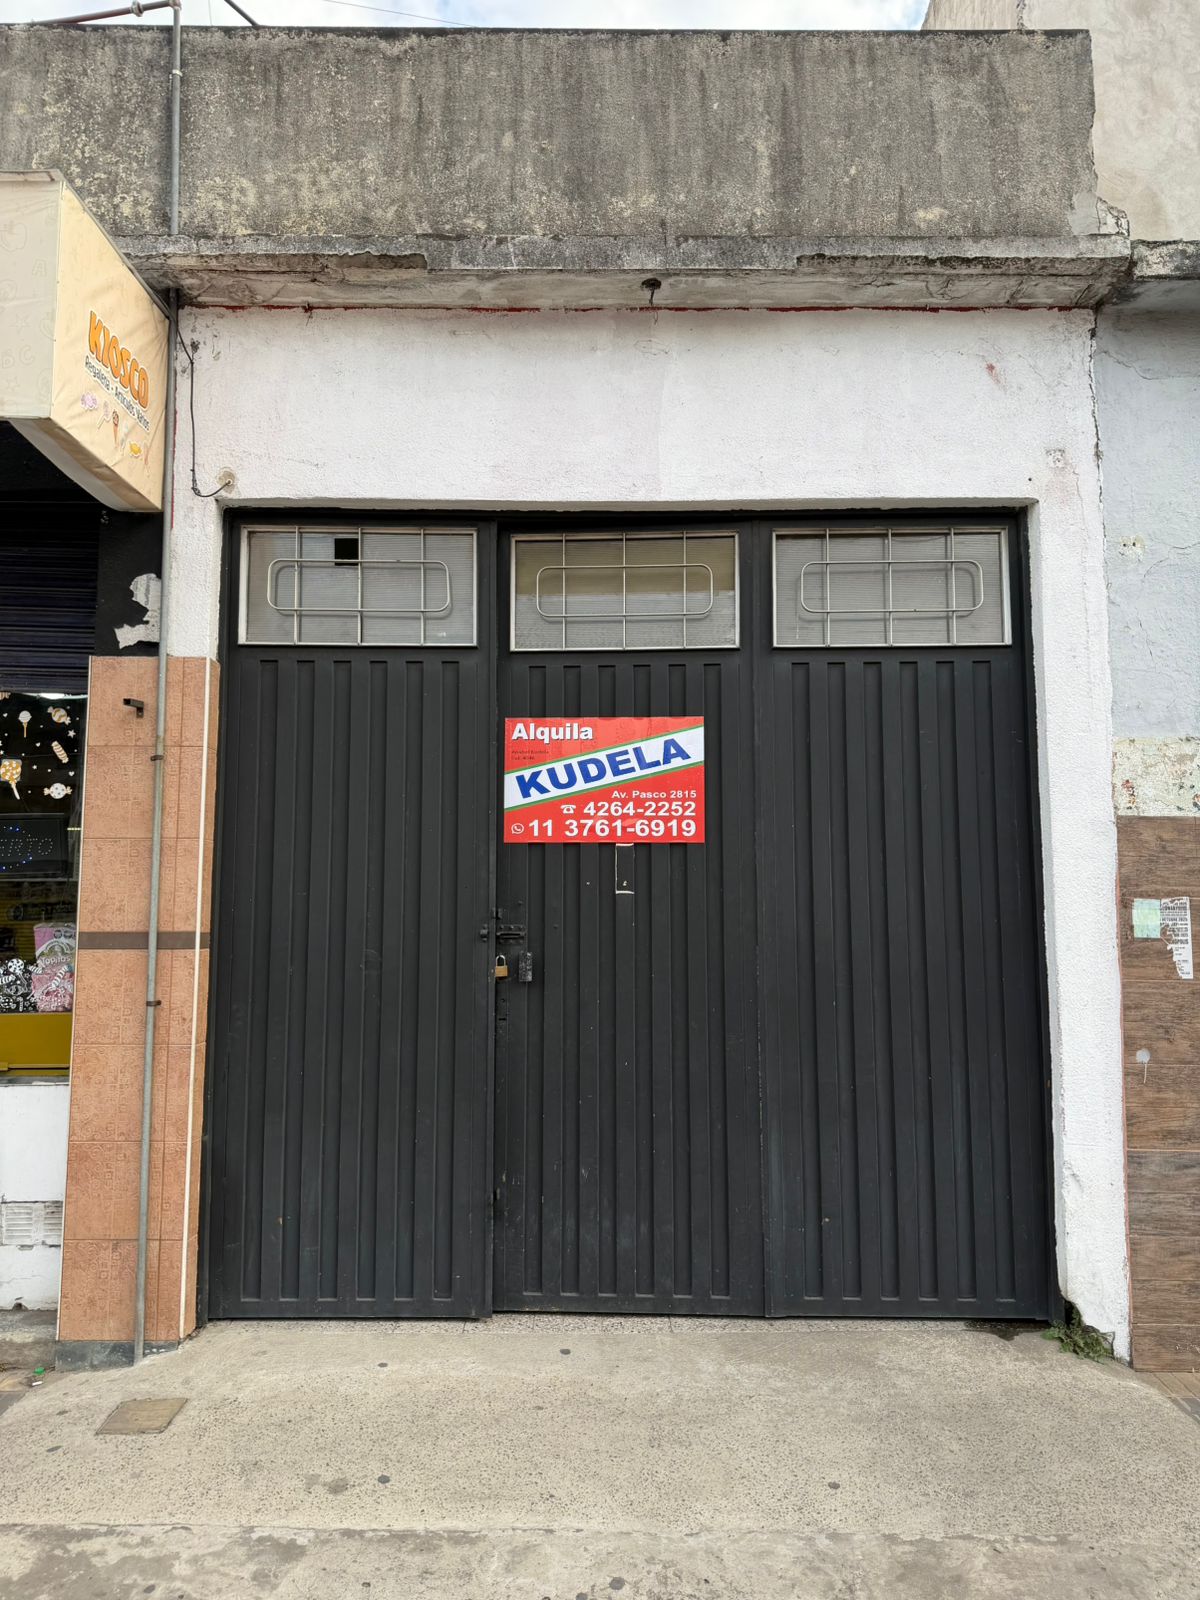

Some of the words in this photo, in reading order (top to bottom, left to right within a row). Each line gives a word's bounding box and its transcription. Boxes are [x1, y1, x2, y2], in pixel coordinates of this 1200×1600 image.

[89, 311, 149, 409] KIOSCO
[511, 722, 593, 744] Alquila
[515, 738, 692, 799] KUDELA
[611, 790, 629, 799] Av.
[632, 790, 667, 799] Pasco
[670, 790, 697, 799] 2815
[583, 801, 697, 816] 4264-2252
[528, 819, 553, 837] 11
[564, 819, 697, 837] 3761-6919
